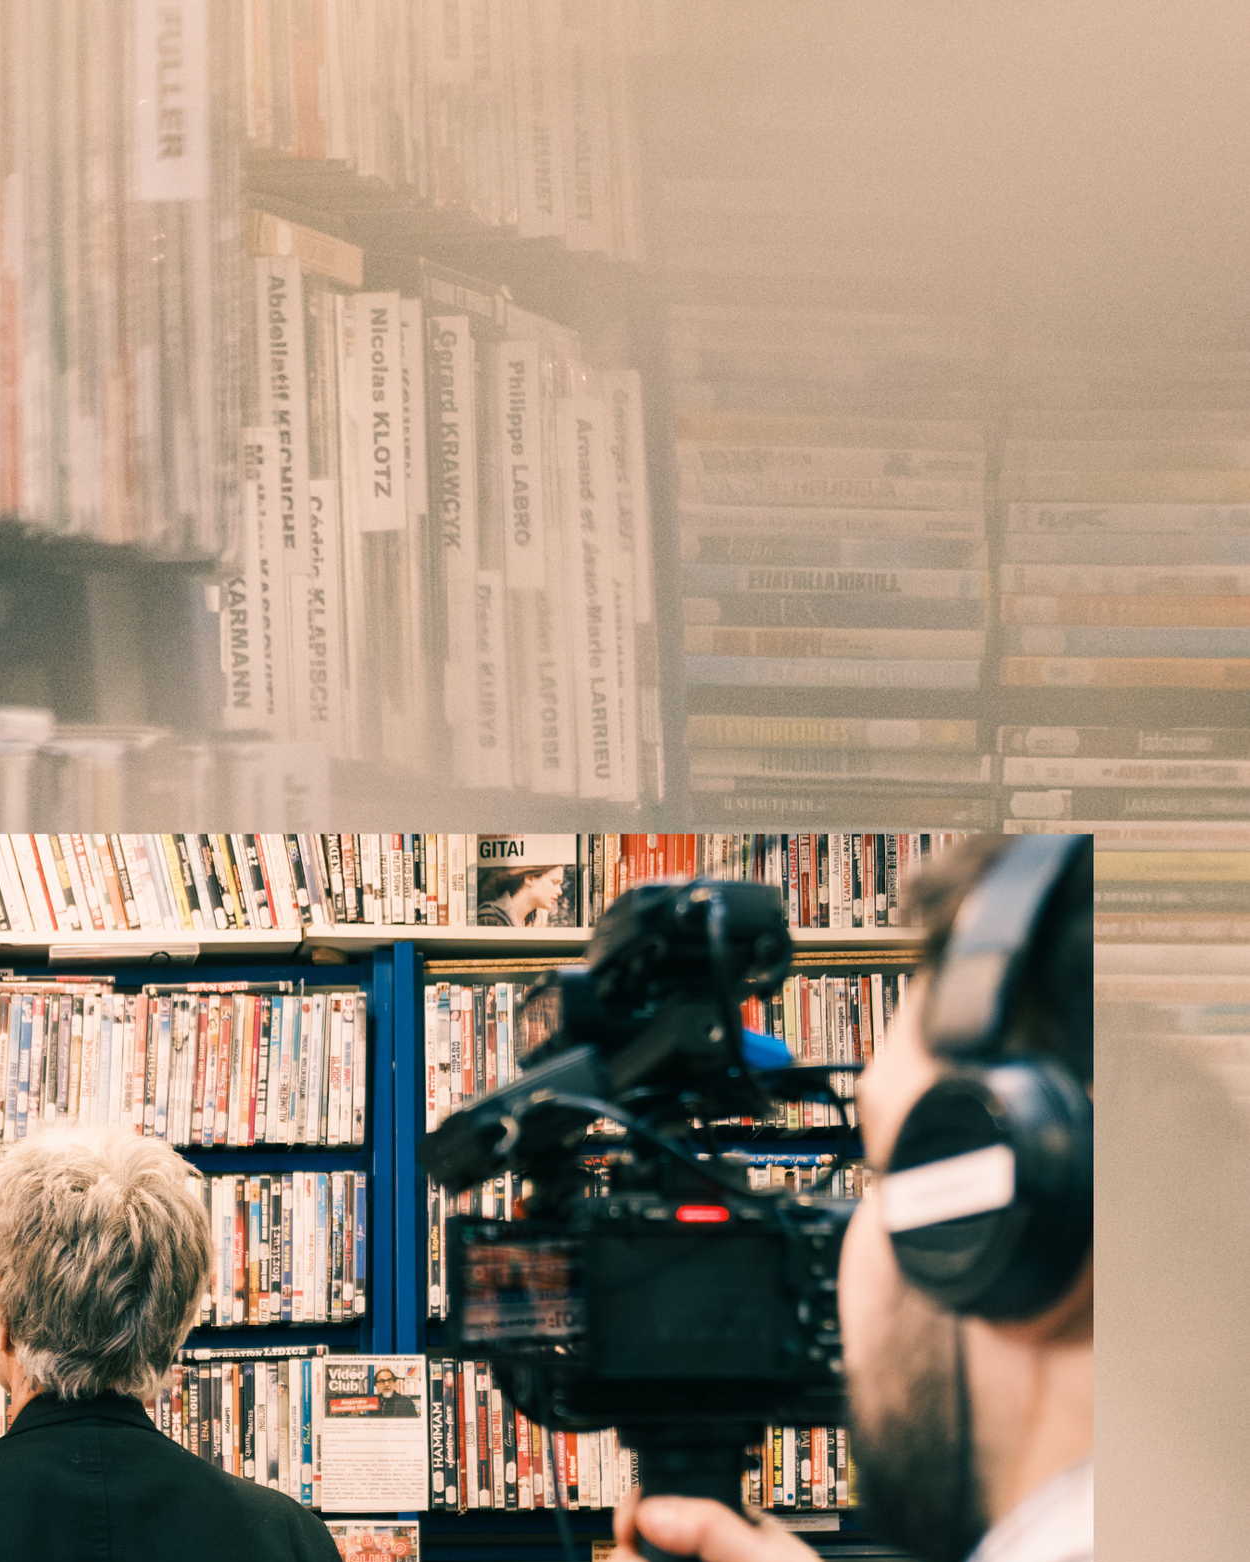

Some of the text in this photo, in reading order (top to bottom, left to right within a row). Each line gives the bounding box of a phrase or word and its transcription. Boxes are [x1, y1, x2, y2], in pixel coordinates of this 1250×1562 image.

[267, 274, 289, 400] Abdellatif
[370, 308, 393, 499] Nicolas KLOTZ
[505, 360, 532, 548] Philippe LABRO
[307, 588, 330, 724] KLAPISCH
[589, 676, 612, 781] LARRIEU
[122, 834, 143, 894] SELF MADE
[393, 852, 401, 872] GITAI
[480, 841, 524, 859] GITAI
[790, 839, 798, 880] CHIARA
[80, 856, 92, 886] ROOM
[393, 875, 401, 896] AMOS
[404, 855, 412, 899] AMOS GITAI
[198, 1032, 206, 1061] tourne
[271, 1008, 280, 1074] VODKA LEMON
[19, 1049, 29, 1082] SHAHADA
[83, 1039, 92, 1097] TRAMONTANE
[147, 1044, 157, 1098] yasmin
[196, 1074, 204, 1107] Silence...
[271, 1225, 281, 1282] Morituri
[264, 1347, 308, 1356] LIDICE
[328, 1367, 365, 1380] Vidéo
[328, 1380, 359, 1392] Club
[189, 1384, 198, 1417] ROUTE
[201, 1420, 209, 1441] LENA
[433, 1402, 443, 1467] HAMMAM
